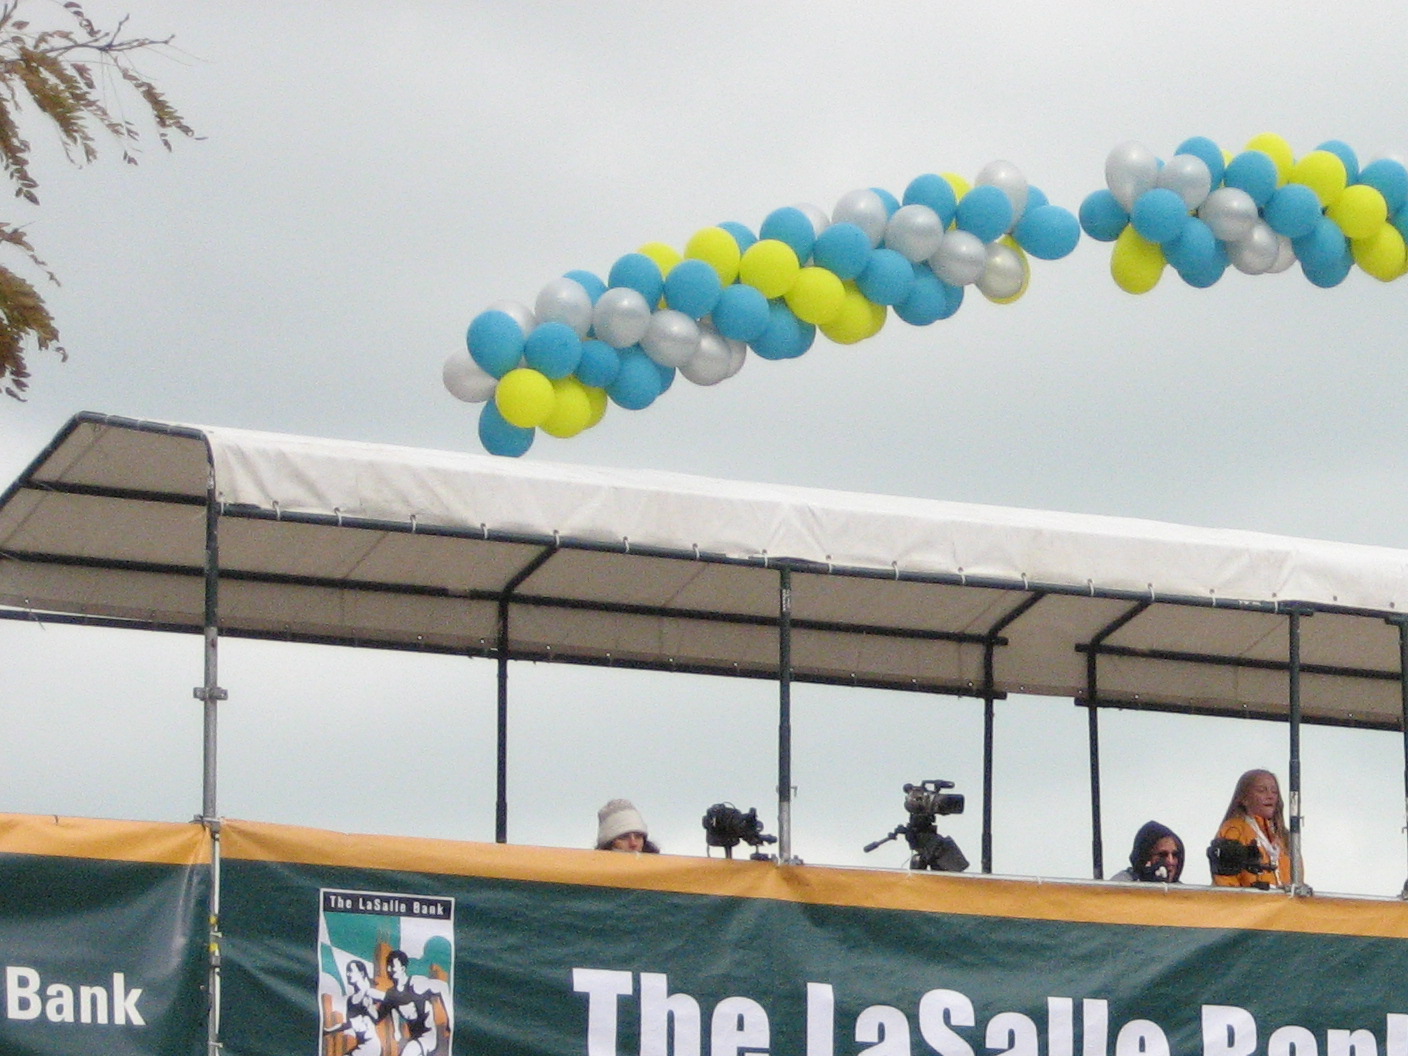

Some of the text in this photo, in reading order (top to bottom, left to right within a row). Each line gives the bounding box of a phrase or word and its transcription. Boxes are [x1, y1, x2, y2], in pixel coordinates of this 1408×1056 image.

[329, 895, 444, 916] The LaSalle Bank
[6, 966, 146, 1026] Bank
